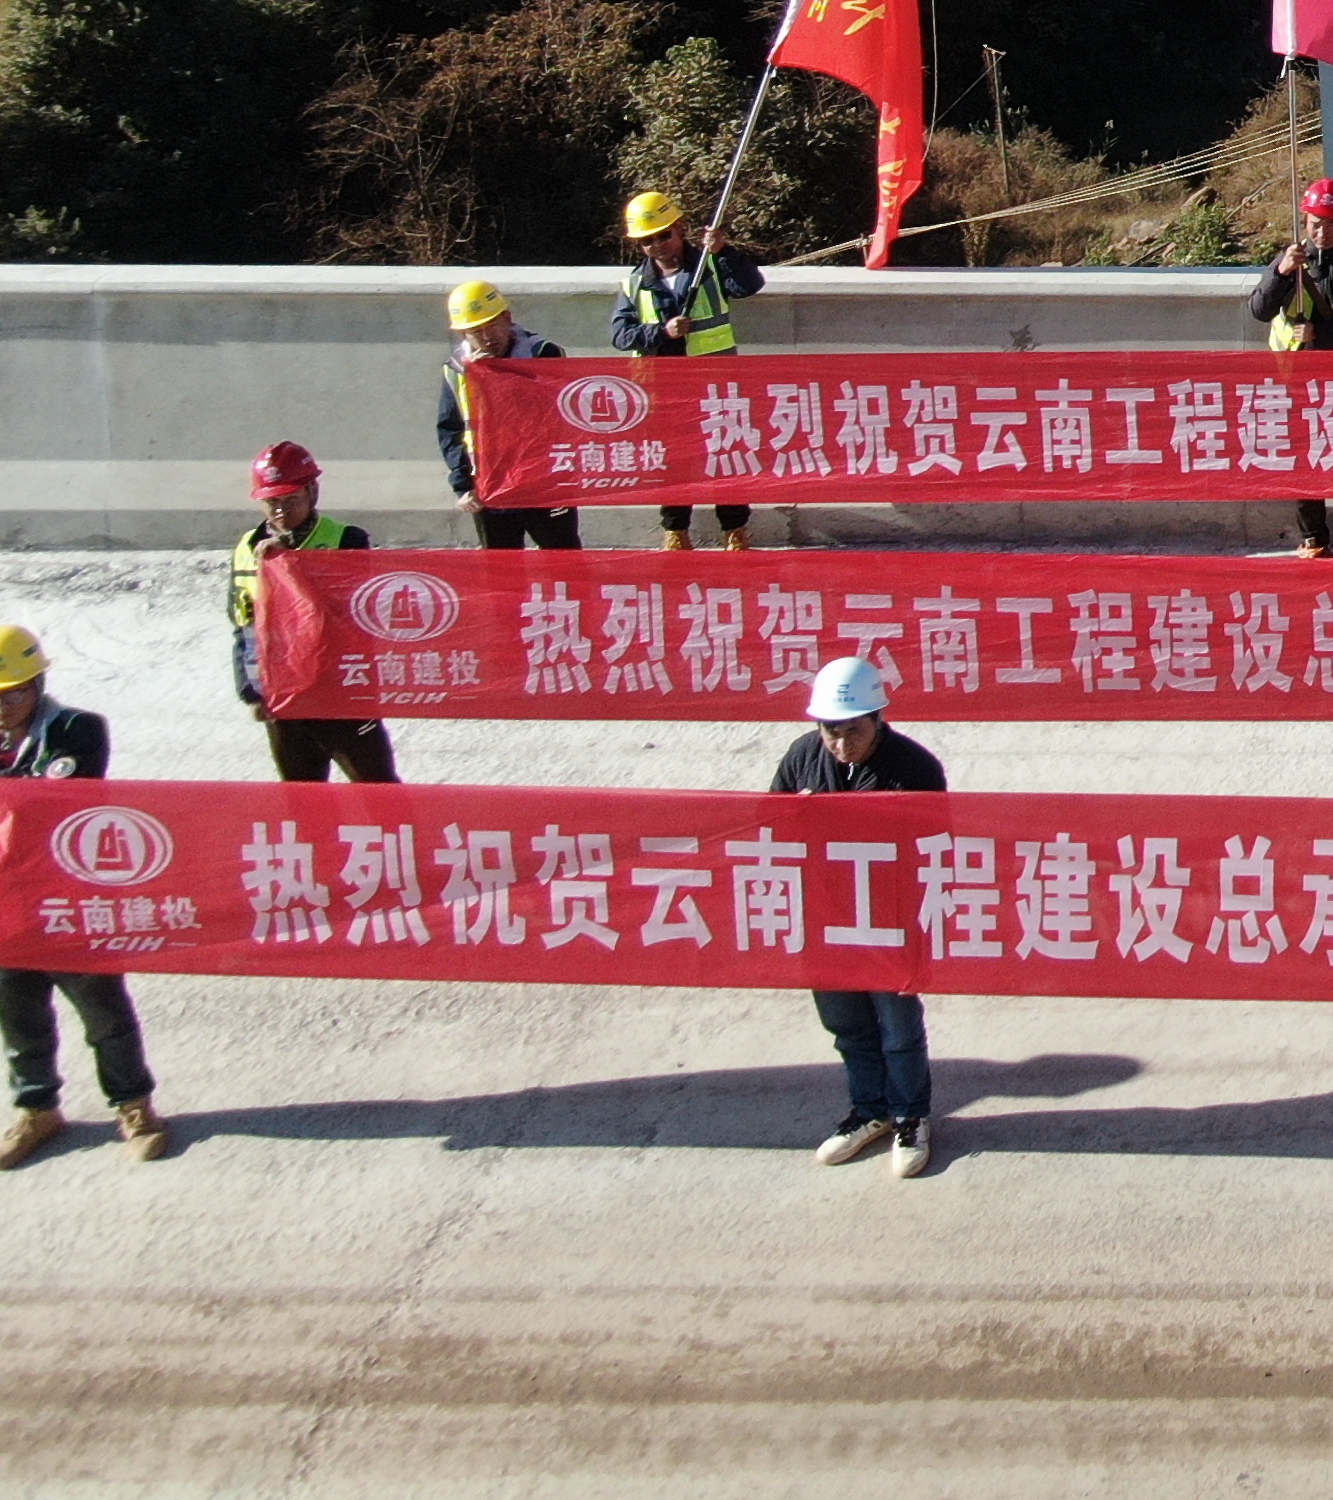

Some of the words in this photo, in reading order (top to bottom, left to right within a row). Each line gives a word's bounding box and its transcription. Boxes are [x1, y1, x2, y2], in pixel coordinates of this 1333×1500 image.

[548, 440, 667, 473] 云南建投
[581, 477, 639, 489] YCIH
[339, 650, 481, 687] 云南建投
[378, 691, 448, 704] YCIH
[39, 895, 202, 935] 云南建投
[89, 936, 166, 952] YCIH
